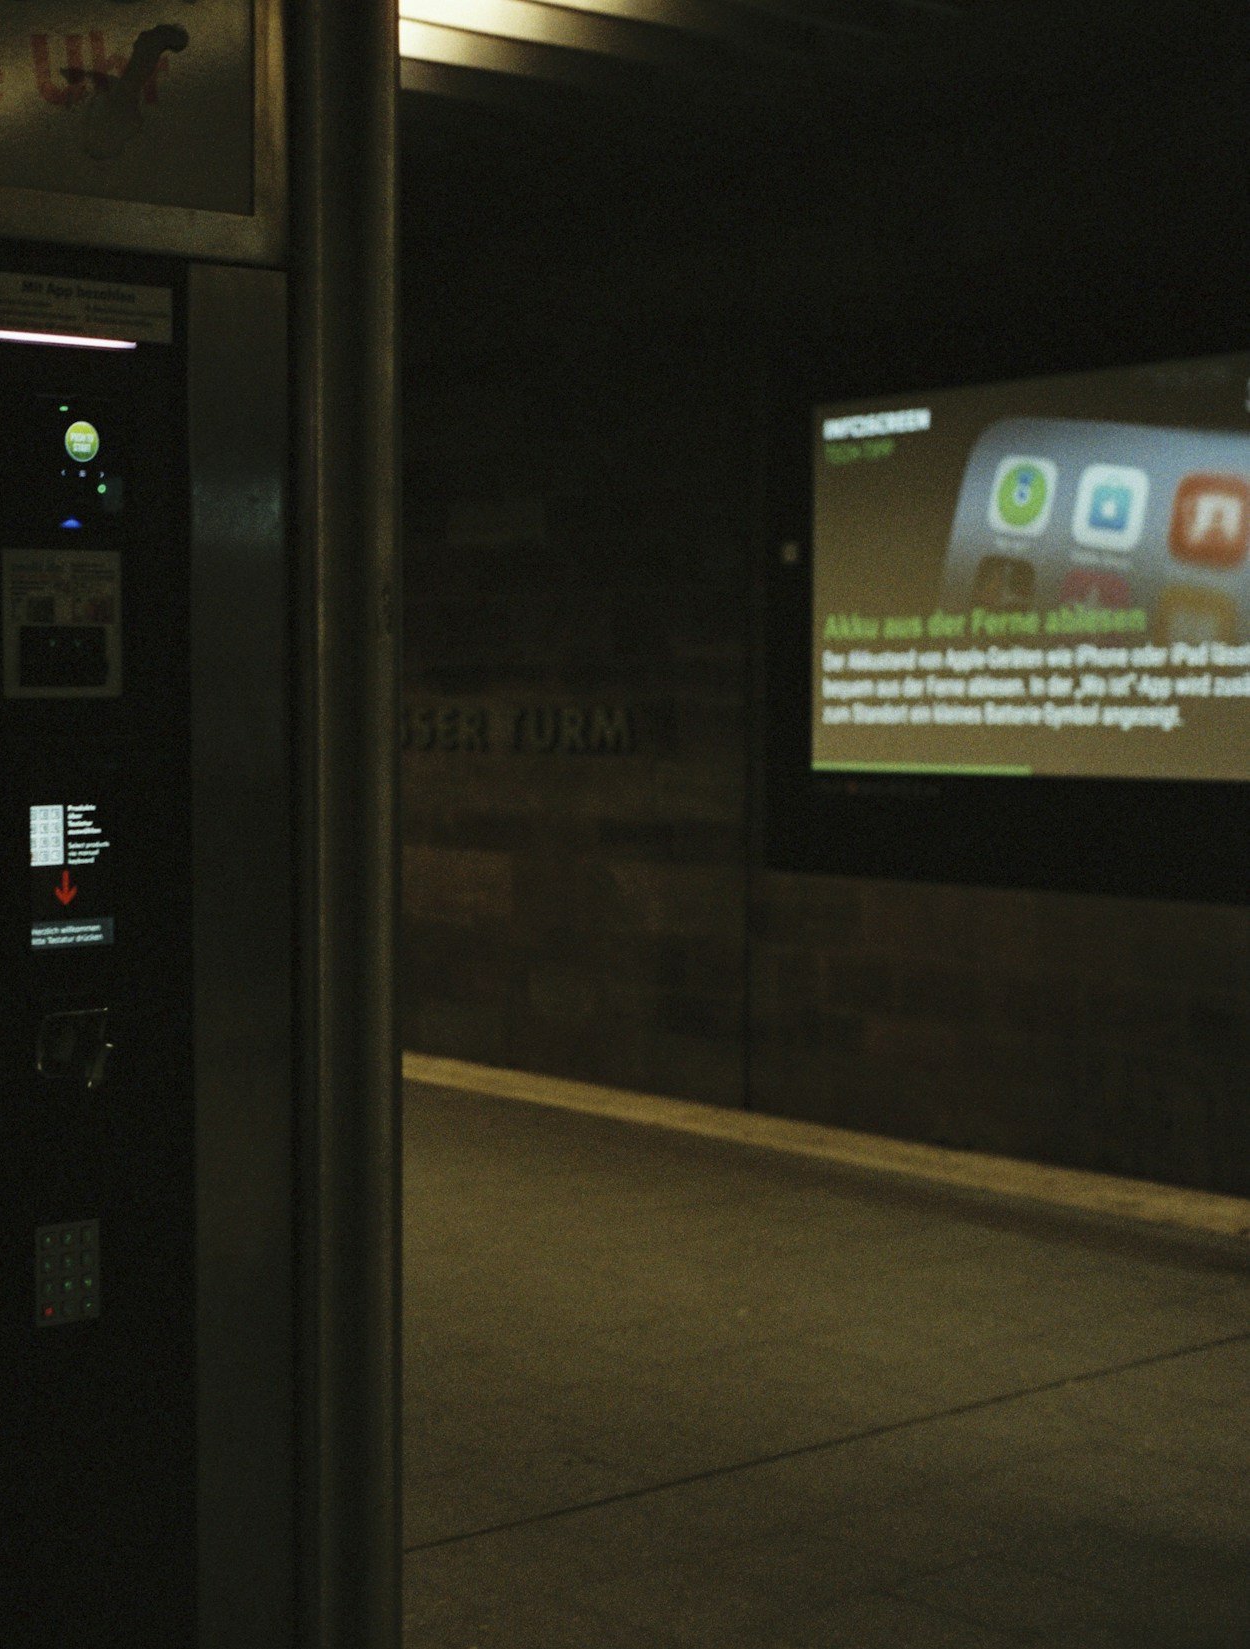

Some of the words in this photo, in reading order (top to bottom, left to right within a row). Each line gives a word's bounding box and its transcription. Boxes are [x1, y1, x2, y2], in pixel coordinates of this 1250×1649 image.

[823, 612, 879, 640] Akku
[882, 616, 924, 640] aus
[927, 609, 967, 638] der
